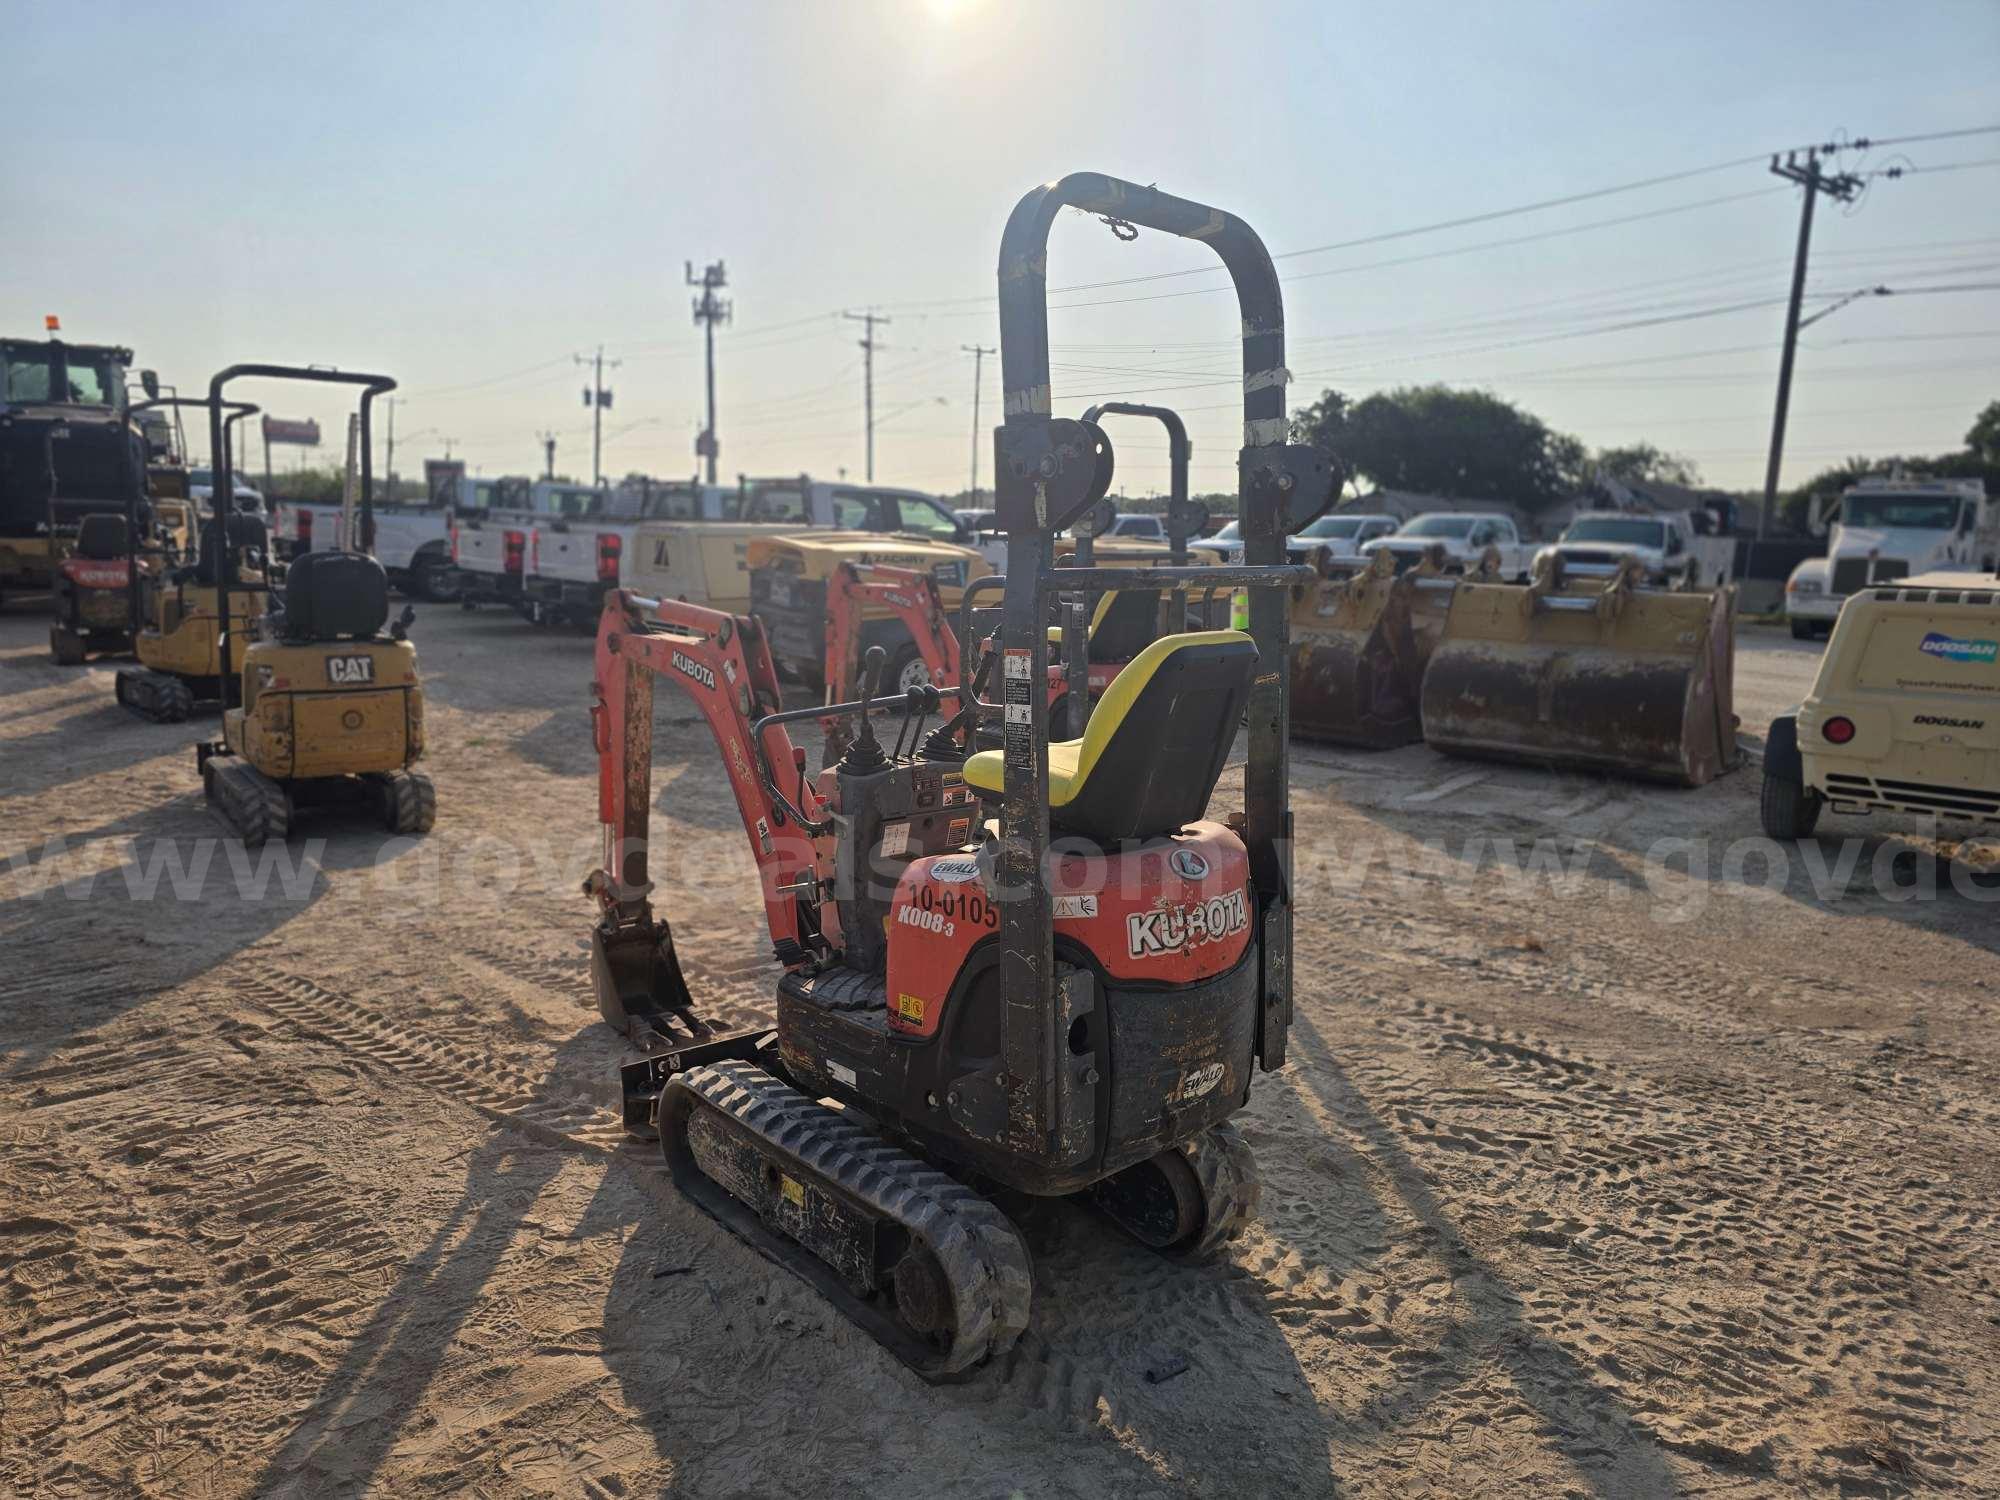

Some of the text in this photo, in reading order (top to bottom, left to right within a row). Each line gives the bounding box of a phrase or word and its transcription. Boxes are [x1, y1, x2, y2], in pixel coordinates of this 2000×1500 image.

[1922, 641, 1997, 655] DOOSAN
[329, 657, 371, 682] CAT
[672, 649, 715, 690] KUBOTA
[1913, 715, 1985, 729] DOOSAN
[934, 862, 977, 875] EWALD
[909, 883, 997, 929] 10-0105
[897, 904, 956, 937] K008-3
[1129, 890, 1248, 956] KUBOTA
[1184, 1065, 1225, 1091] EWALD
